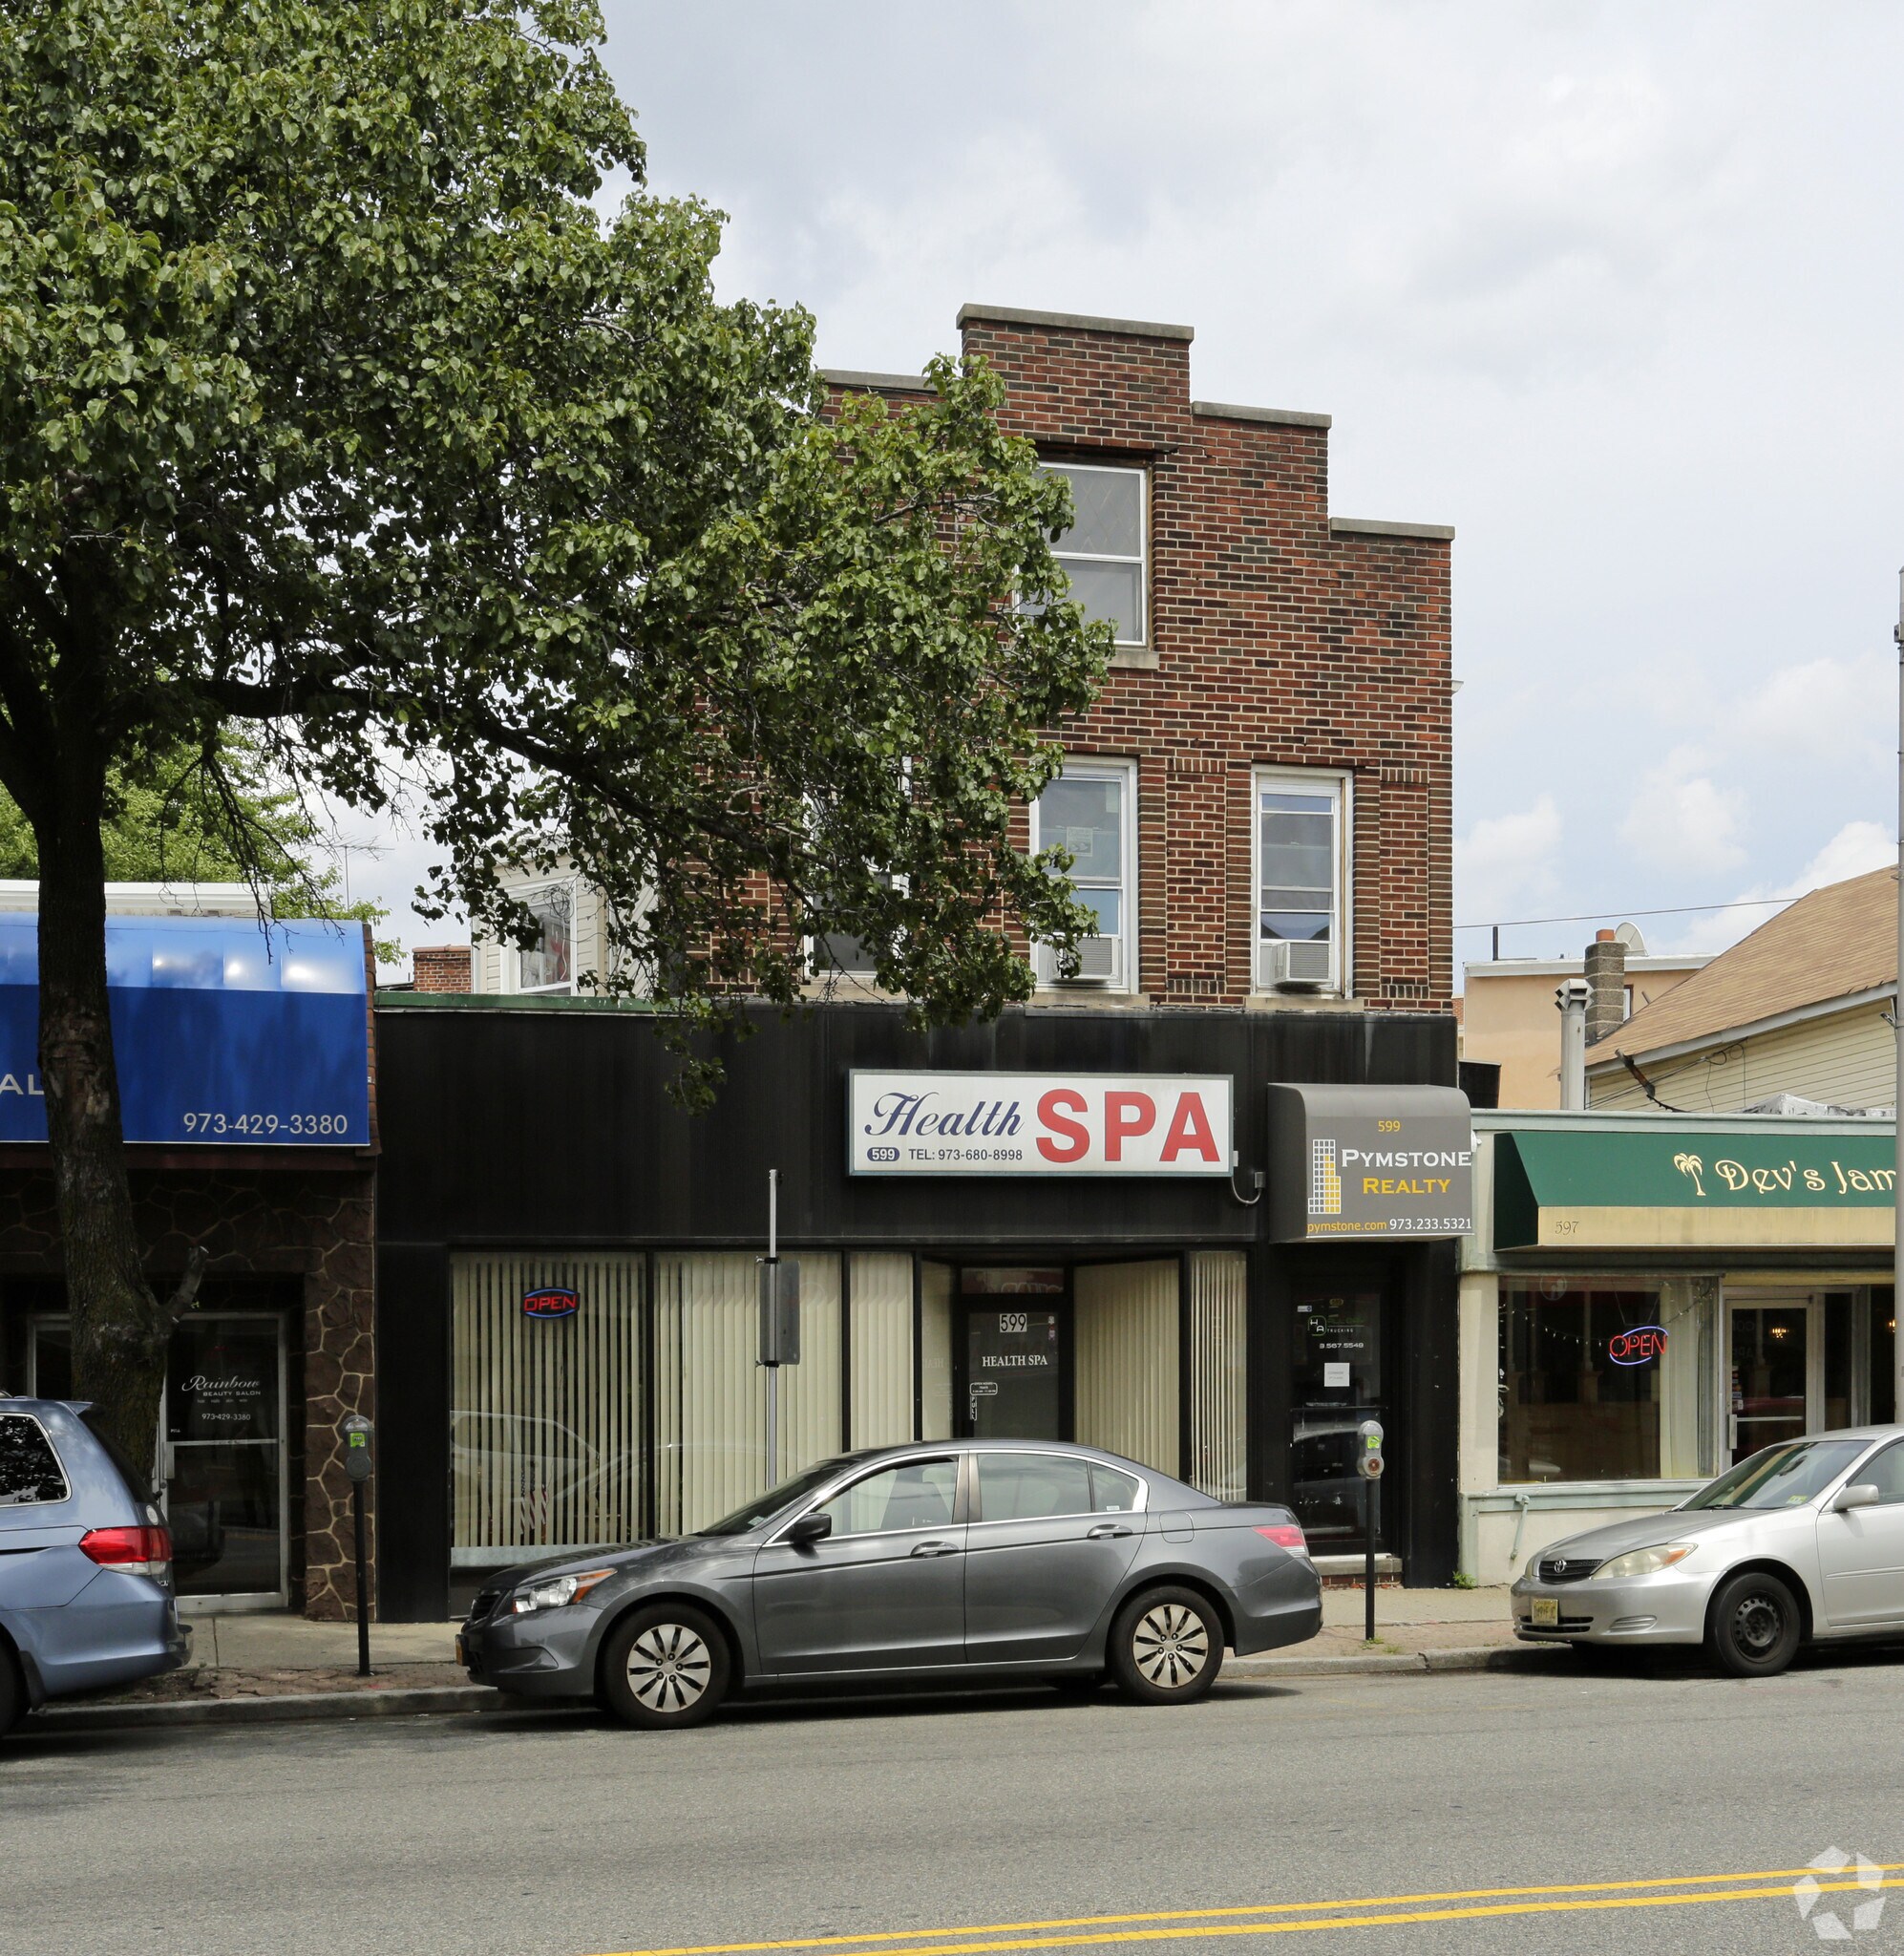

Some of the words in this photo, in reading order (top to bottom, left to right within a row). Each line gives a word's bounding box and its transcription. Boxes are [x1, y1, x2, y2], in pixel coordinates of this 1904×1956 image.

[183, 1113, 348, 1135] 973-429-3380
[864, 1092, 1025, 1137] Health
[1035, 1088, 1221, 1163] SPA
[1378, 1120, 1401, 1132] 599
[871, 1148, 896, 1160] 599
[908, 1149, 935, 1160] TEL:
[938, 1148, 1023, 1160] 973-680-8998
[1342, 1149, 1471, 1167] PYMSTONE
[1715, 1159, 1826, 1194] Dev's
[1363, 1178, 1450, 1194] REALTY
[1307, 1221, 1386, 1233] pymstone.com
[1389, 1218, 1472, 1230] 973.233.5321
[1555, 1220, 1579, 1235] 597
[523, 1296, 578, 1311] OPEN
[1000, 1314, 1026, 1331] 599
[1609, 1333, 1668, 1357] OPEN
[982, 1355, 1026, 1367] HEALTH
[1028, 1354, 1048, 1366] SPA
[181, 1375, 260, 1392] Rainbow
